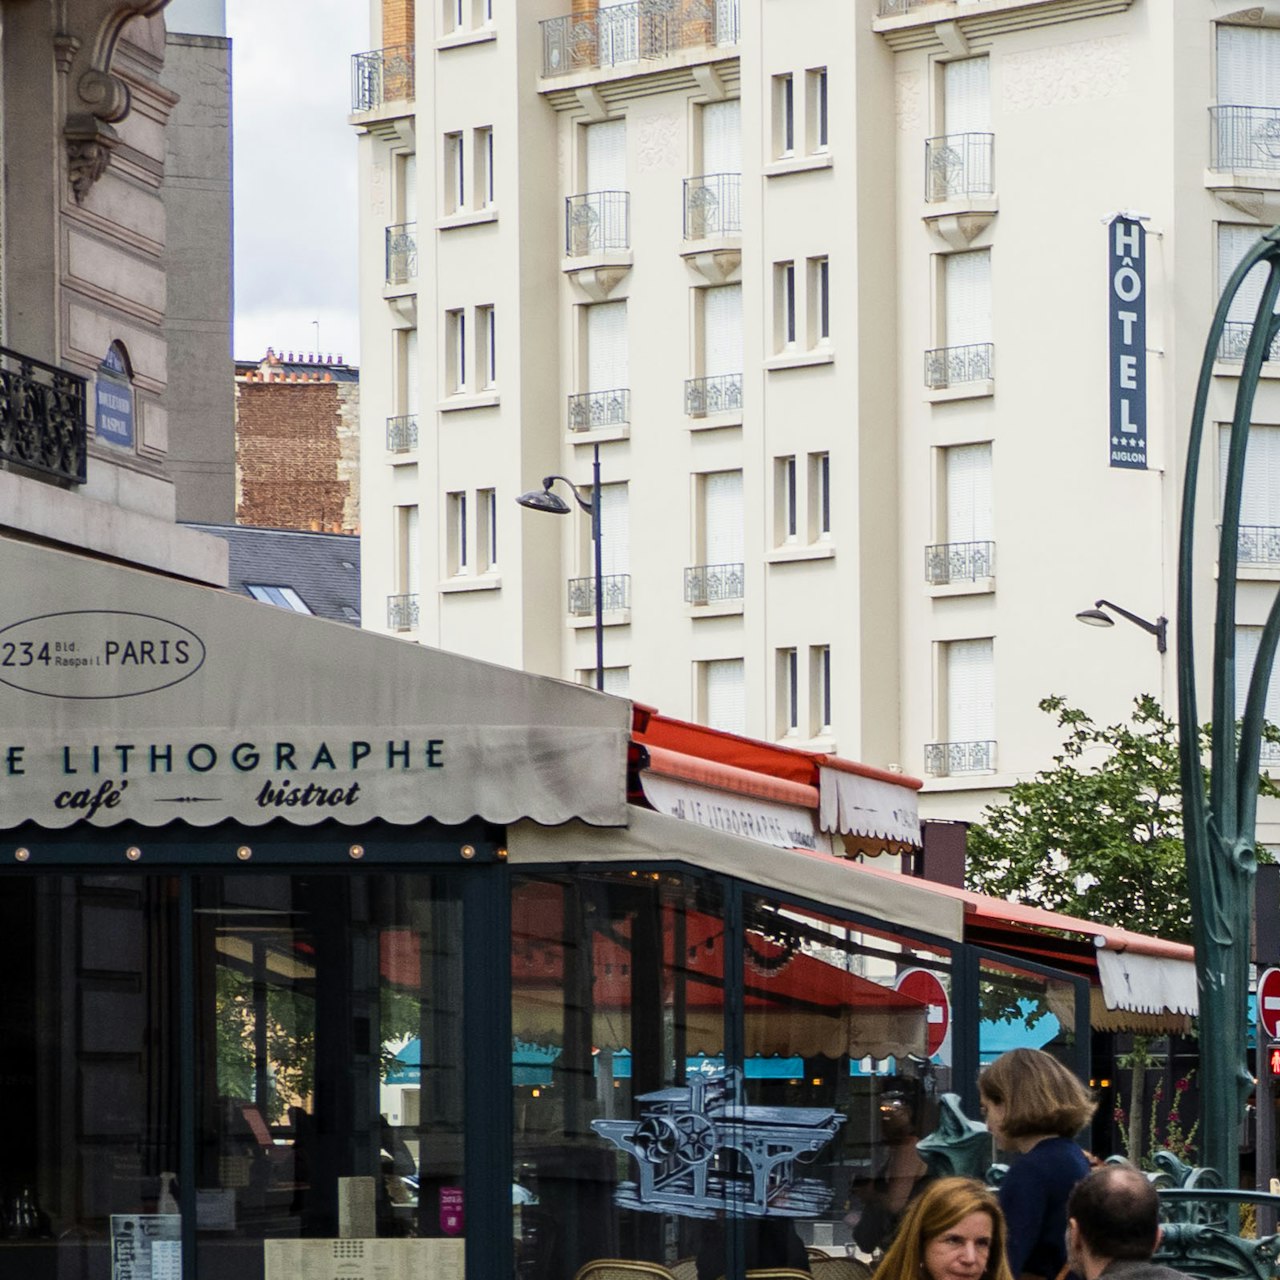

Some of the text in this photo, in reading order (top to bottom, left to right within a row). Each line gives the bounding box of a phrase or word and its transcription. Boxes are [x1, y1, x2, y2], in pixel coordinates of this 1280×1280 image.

[1114, 223, 1141, 433] HÔTEL
[1111, 451, 1146, 463] AIGLON
[2, 642, 51, 667] 234
[105, 640, 190, 665] PARIS
[55, 656, 100, 667] Raspail
[64, 739, 444, 773] LITHOGRAPHE
[54, 780, 361, 819] café bistrot
